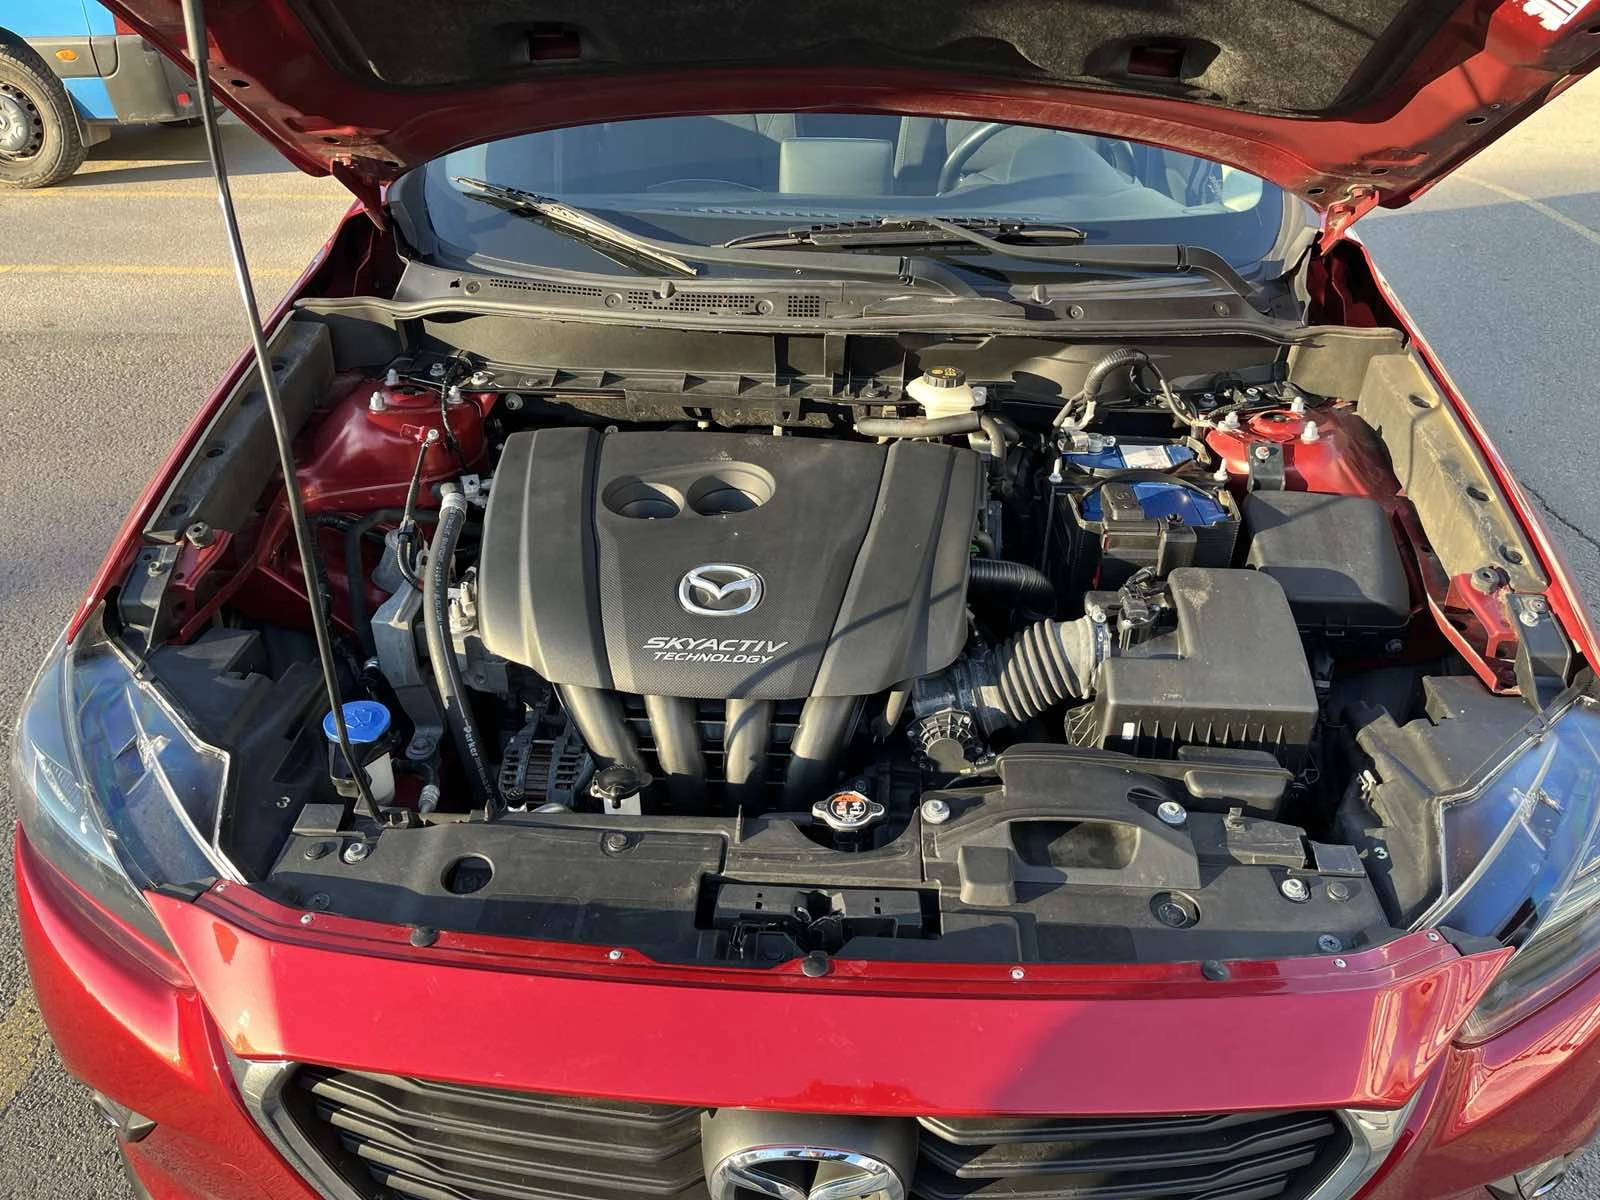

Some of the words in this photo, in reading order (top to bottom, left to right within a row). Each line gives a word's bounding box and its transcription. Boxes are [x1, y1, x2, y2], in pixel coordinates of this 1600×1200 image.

[643, 636, 788, 653] SKYACTIV
[653, 651, 774, 664] TECHNOLOGY
[463, 726, 478, 757] Parker
[1374, 846, 1388, 859] 3
